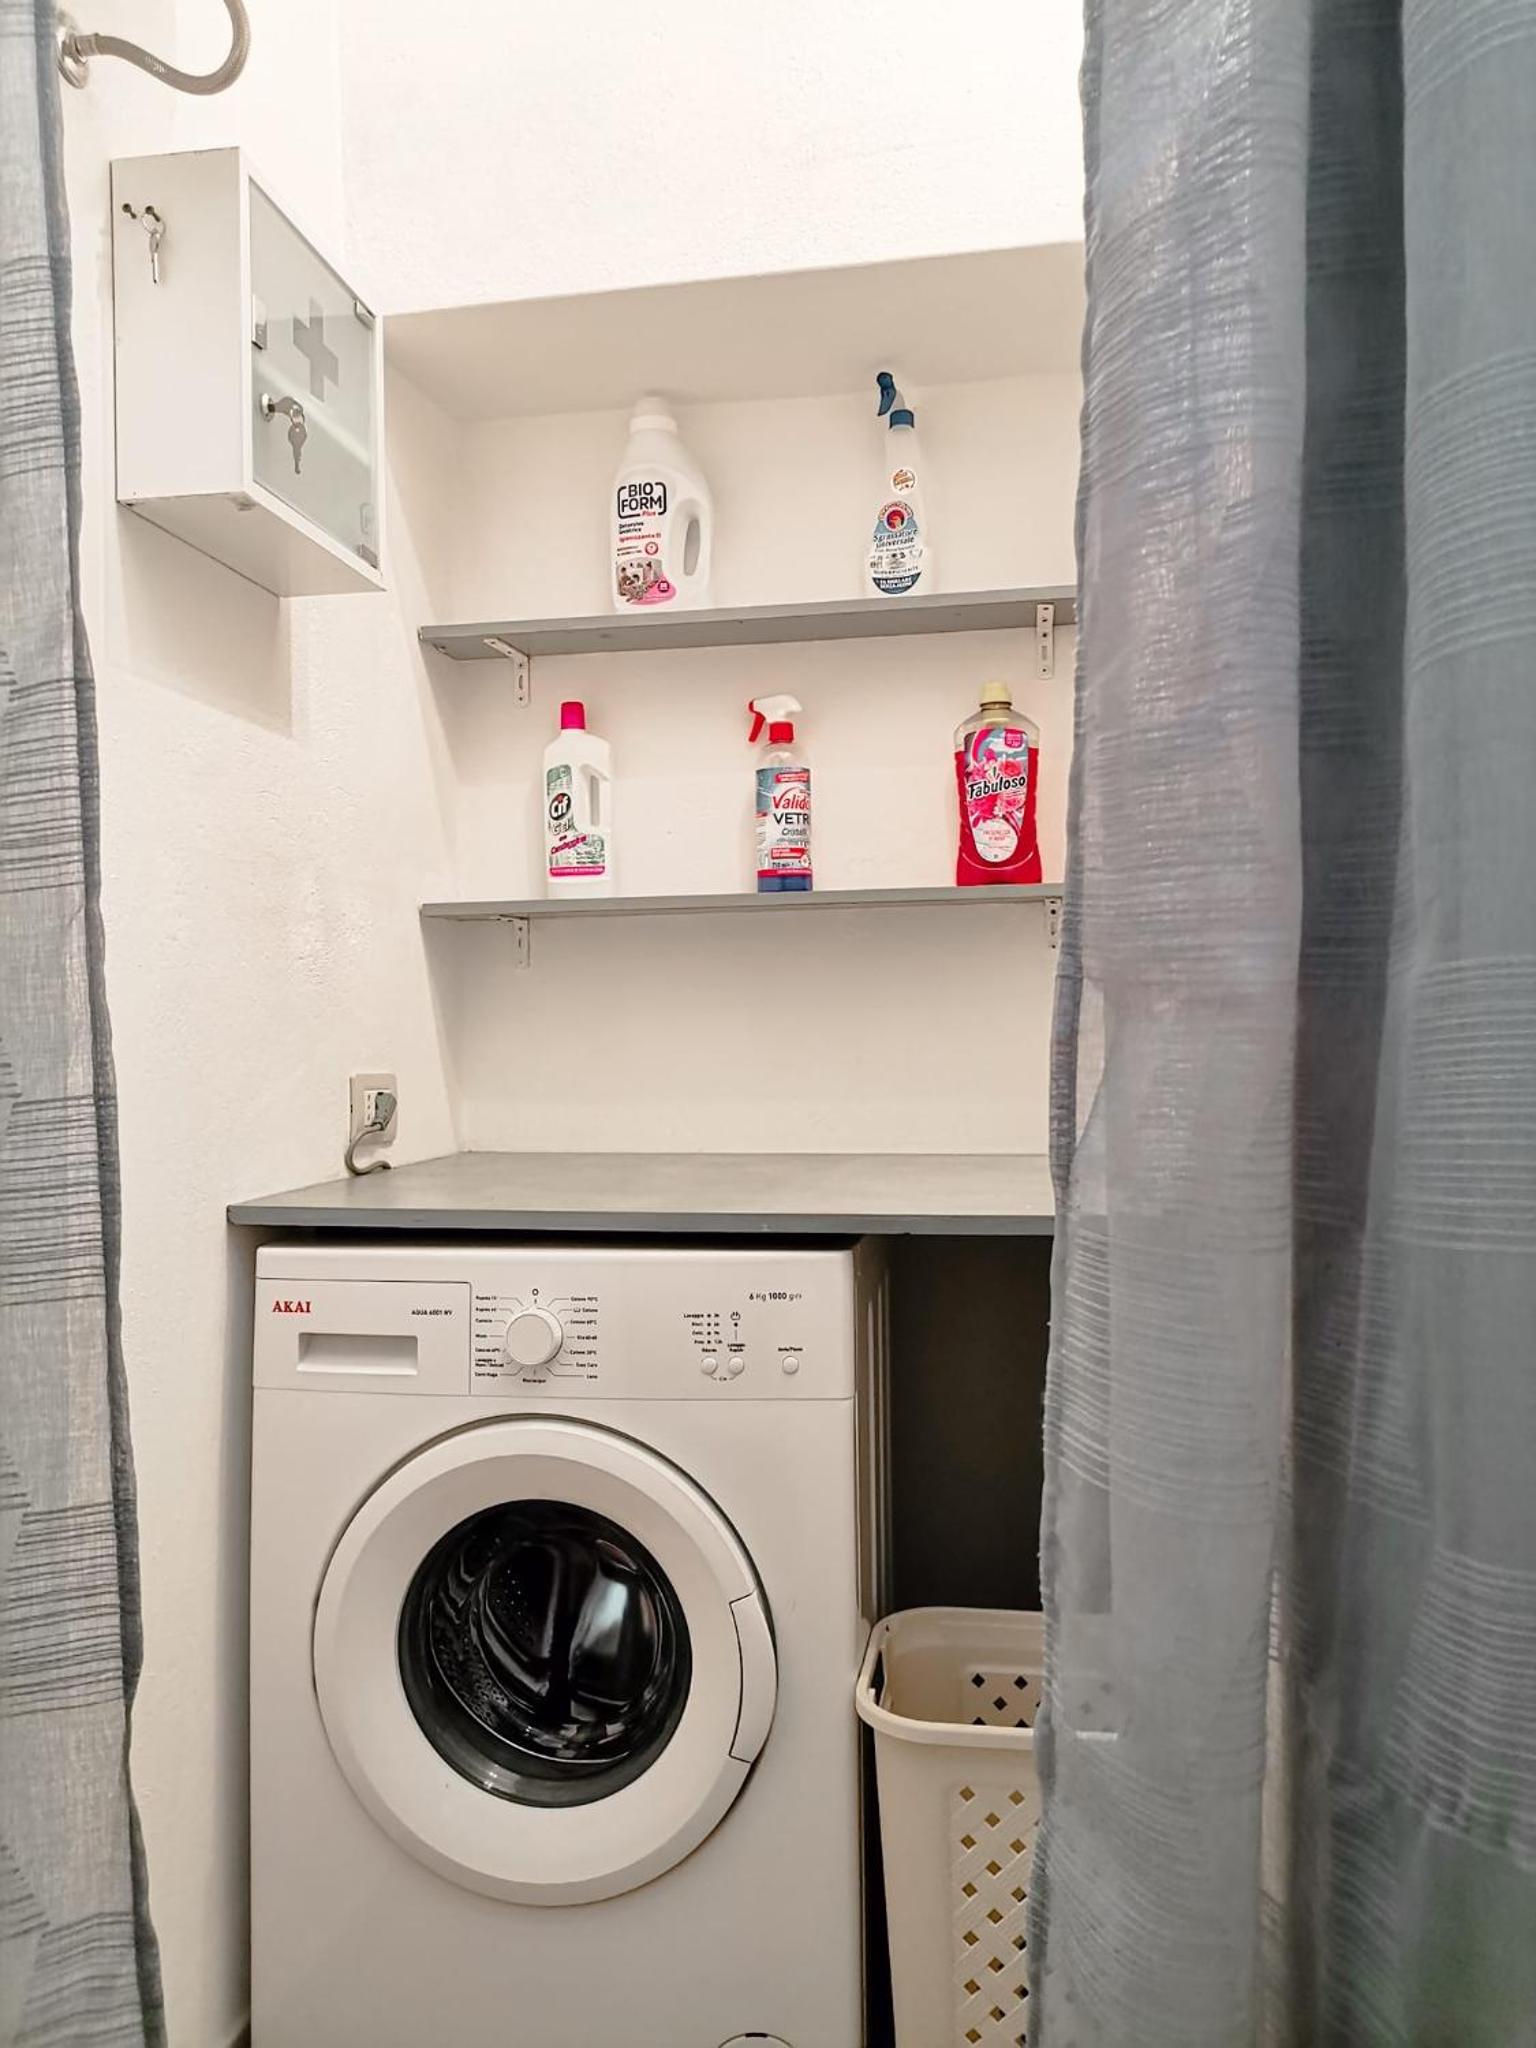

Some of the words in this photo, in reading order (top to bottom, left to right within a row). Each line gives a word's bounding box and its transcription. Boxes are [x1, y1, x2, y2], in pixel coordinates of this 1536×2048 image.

[628, 482, 654, 497] BIO
[621, 495, 662, 512] FORM
[968, 776, 1026, 799] Fabuloso
[551, 794, 569, 818] Cif
[749, 1292, 755, 1300] 6
[756, 1293, 767, 1302] Kg
[768, 1292, 787, 1300] 1000
[272, 1301, 312, 1313] AKAI
